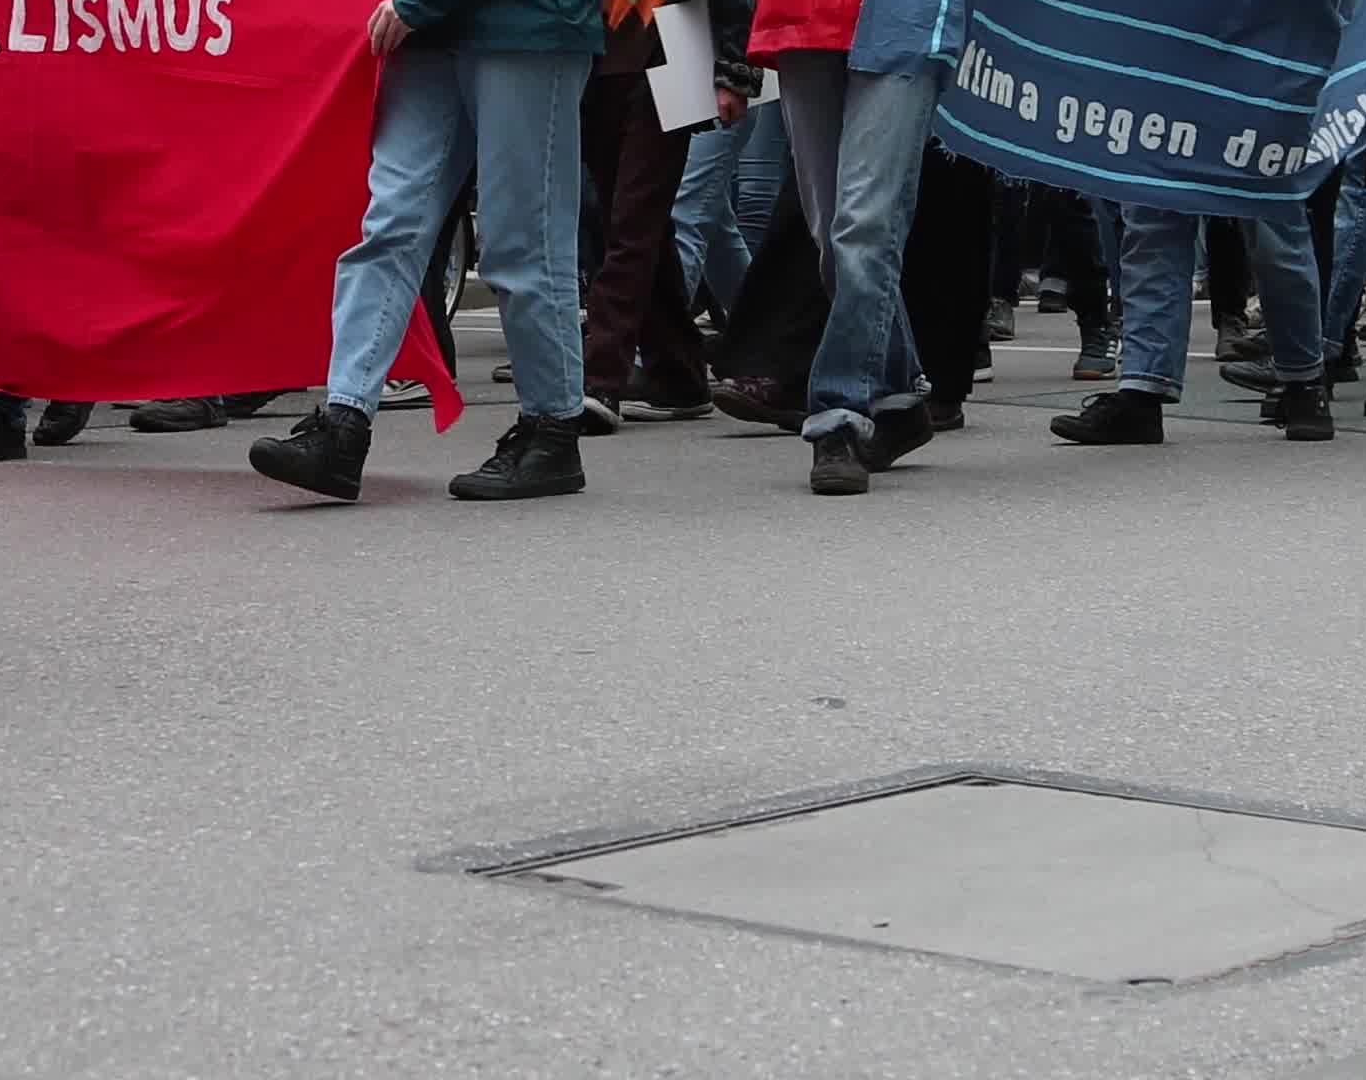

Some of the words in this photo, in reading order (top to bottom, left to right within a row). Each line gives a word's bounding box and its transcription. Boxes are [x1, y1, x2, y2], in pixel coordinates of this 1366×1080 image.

[957, 39, 1039, 121] Klima
[1055, 95, 1198, 158] gegen
[1223, 128, 1307, 177] den
